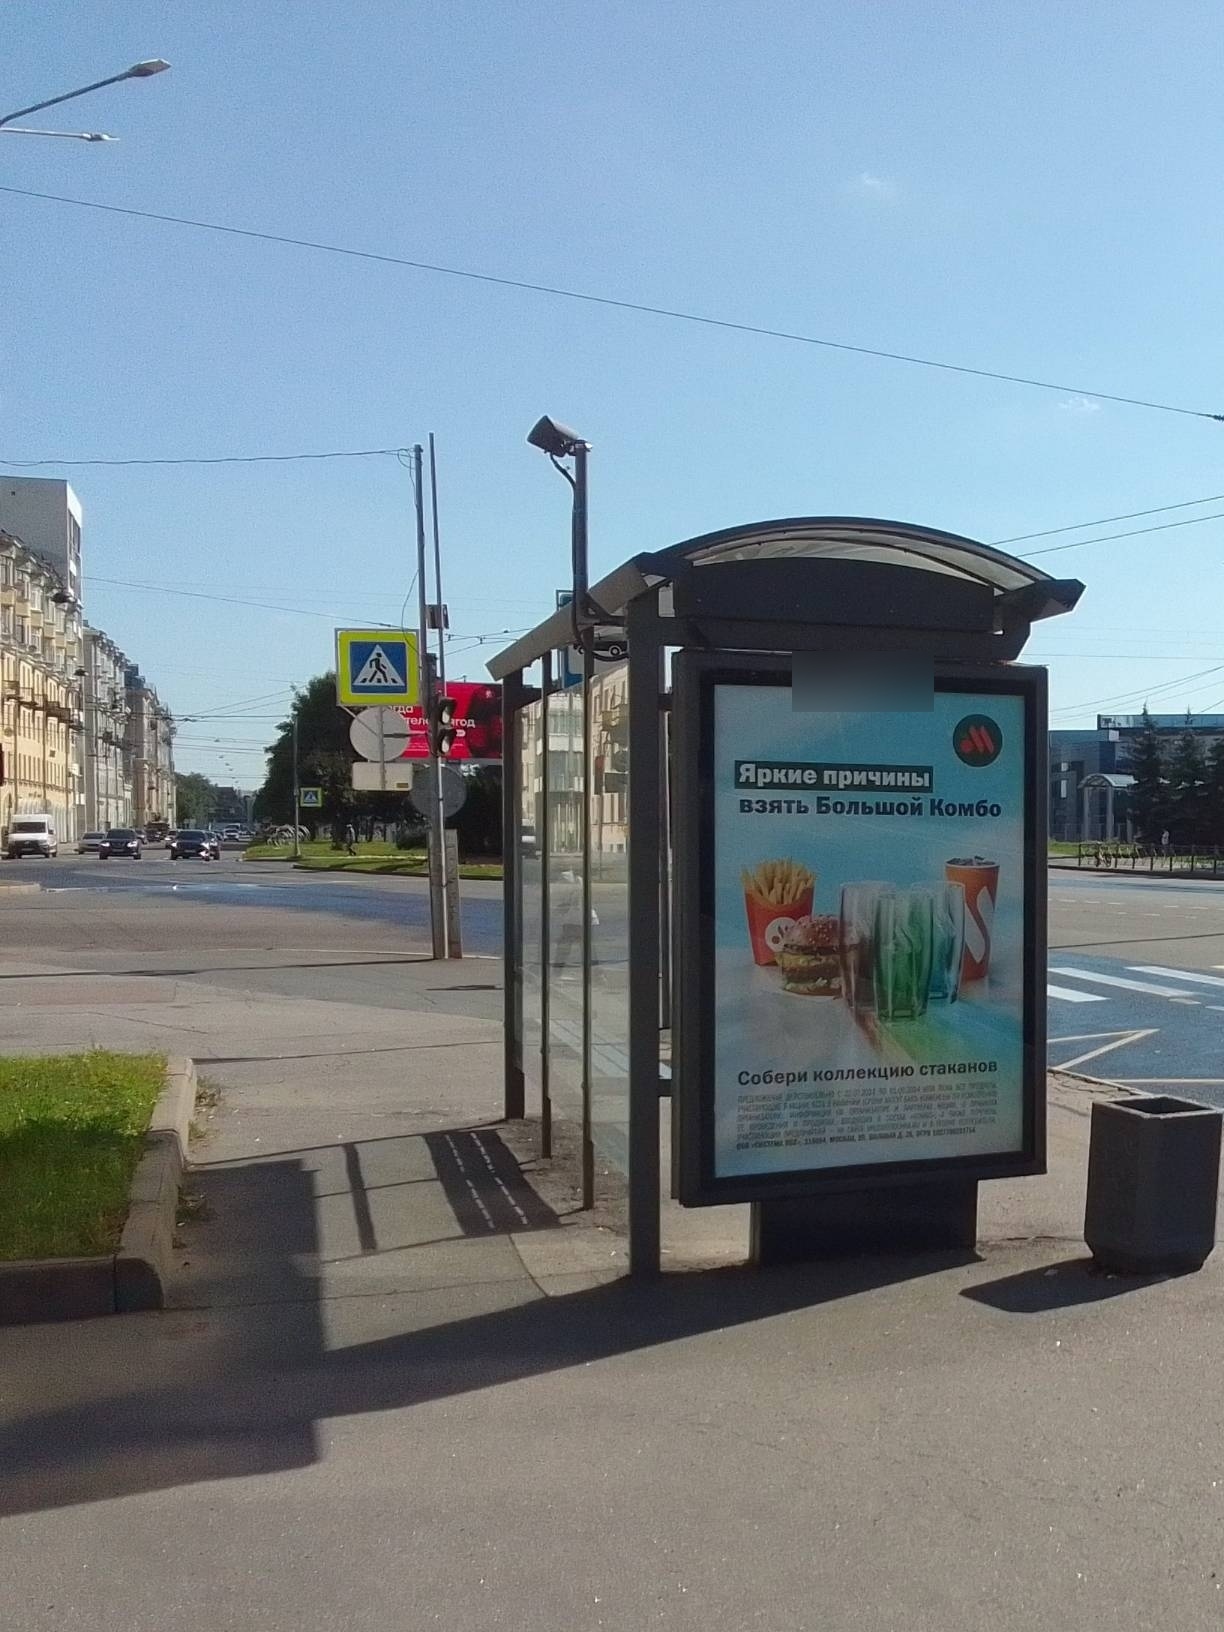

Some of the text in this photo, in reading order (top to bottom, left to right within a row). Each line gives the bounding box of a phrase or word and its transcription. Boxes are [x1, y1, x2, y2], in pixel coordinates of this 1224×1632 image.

[738, 763, 930, 789] Яркие причины
[739, 795, 1002, 817] взять Большой Комбо
[738, 1061, 998, 1087] Собери коллекцию стаканов
